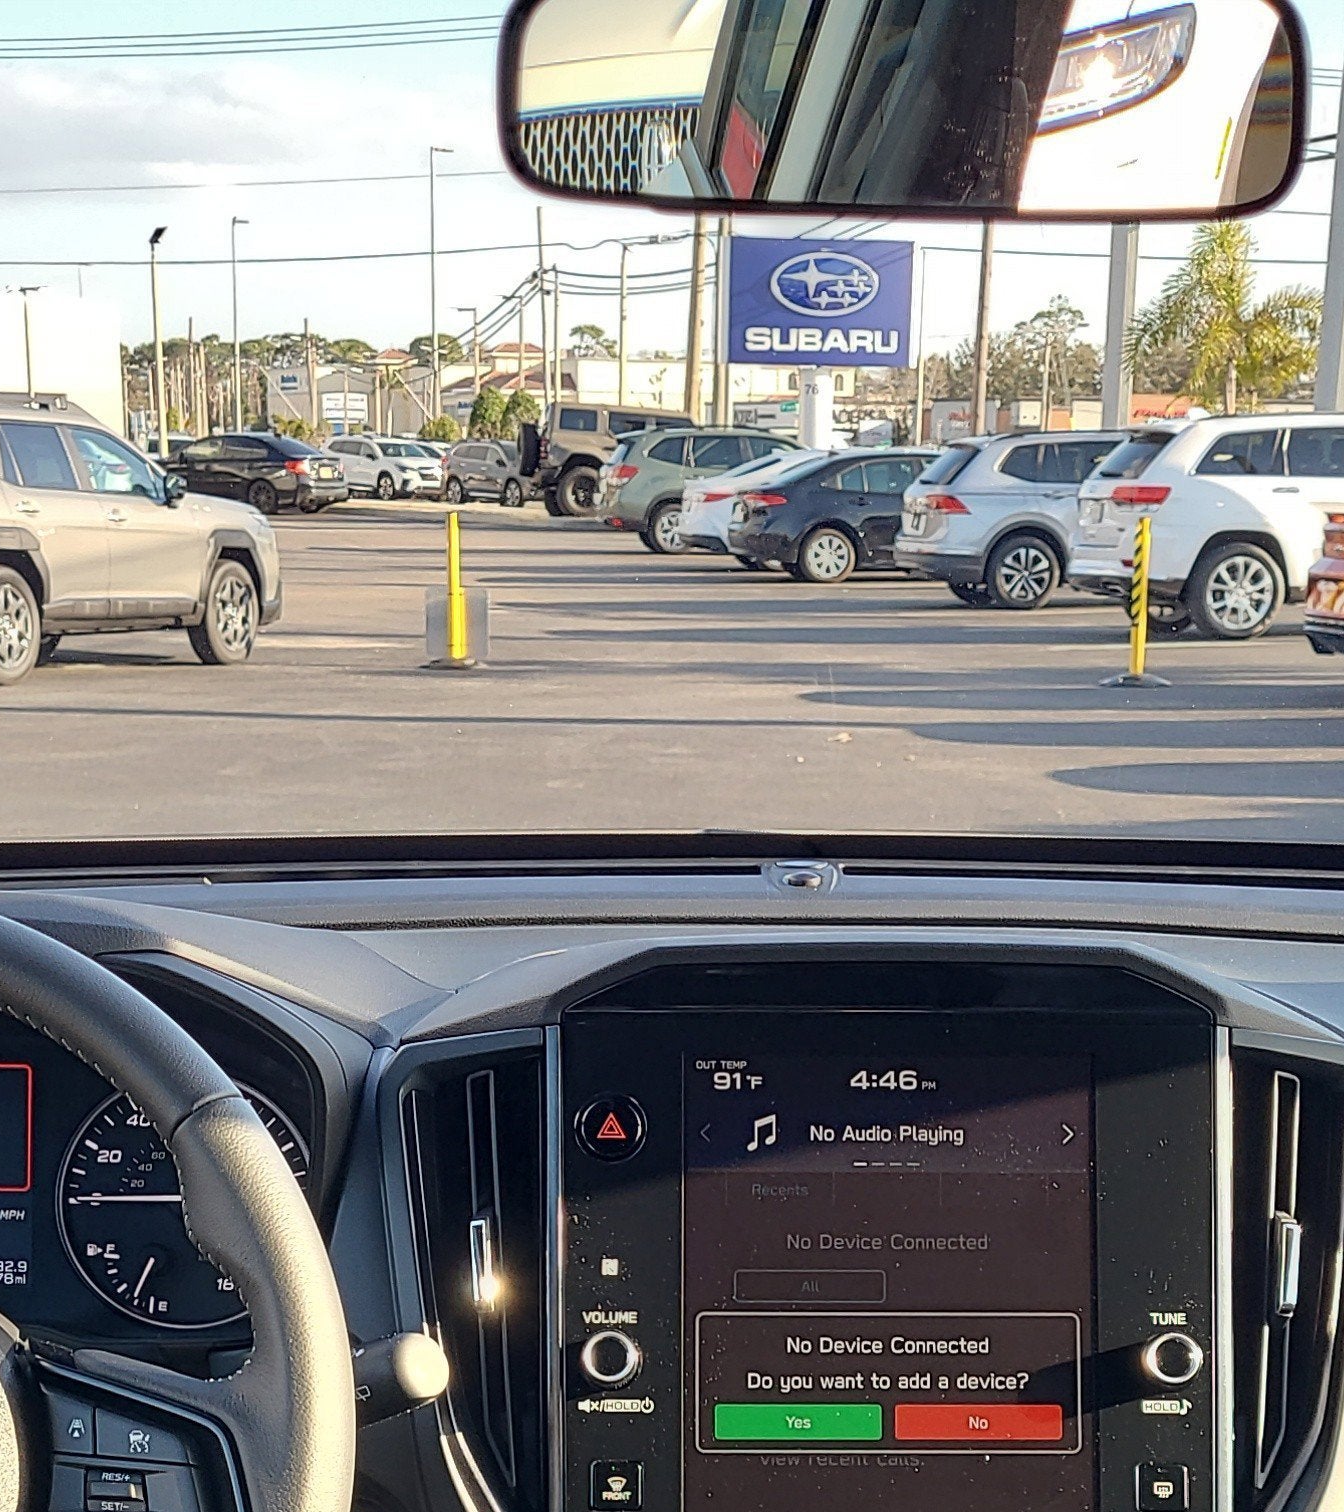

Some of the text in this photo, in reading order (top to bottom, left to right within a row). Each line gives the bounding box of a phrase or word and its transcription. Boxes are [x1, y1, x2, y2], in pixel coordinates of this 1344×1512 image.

[744, 326, 899, 354] SUBARU
[696, 1060, 747, 1070] OUT TEMP
[850, 1070, 936, 1090] 4:46 PM
[810, 1124, 964, 1146] No Audio Playing
[97, 1151, 122, 1164] 20
[138, 1163, 153, 1172] 40
[130, 1179, 145, 1188] 20
[751, 1183, 809, 1197] Recents
[0, 1209, 25, 1221] MPH
[786, 1233, 988, 1250] No Device Connected
[801, 1281, 820, 1292] All
[158, 1302, 168, 1312] E
[582, 1311, 638, 1324] VOLUME
[1150, 1312, 1187, 1325] TUNE
[786, 1336, 989, 1354] No Device Connected
[747, 1373, 1029, 1393] Do you want to add a device?
[606, 1402, 640, 1411] HOLD
[1144, 1402, 1179, 1411] HOLD
[785, 1415, 811, 1429] Yes
[969, 1416, 989, 1430] No
